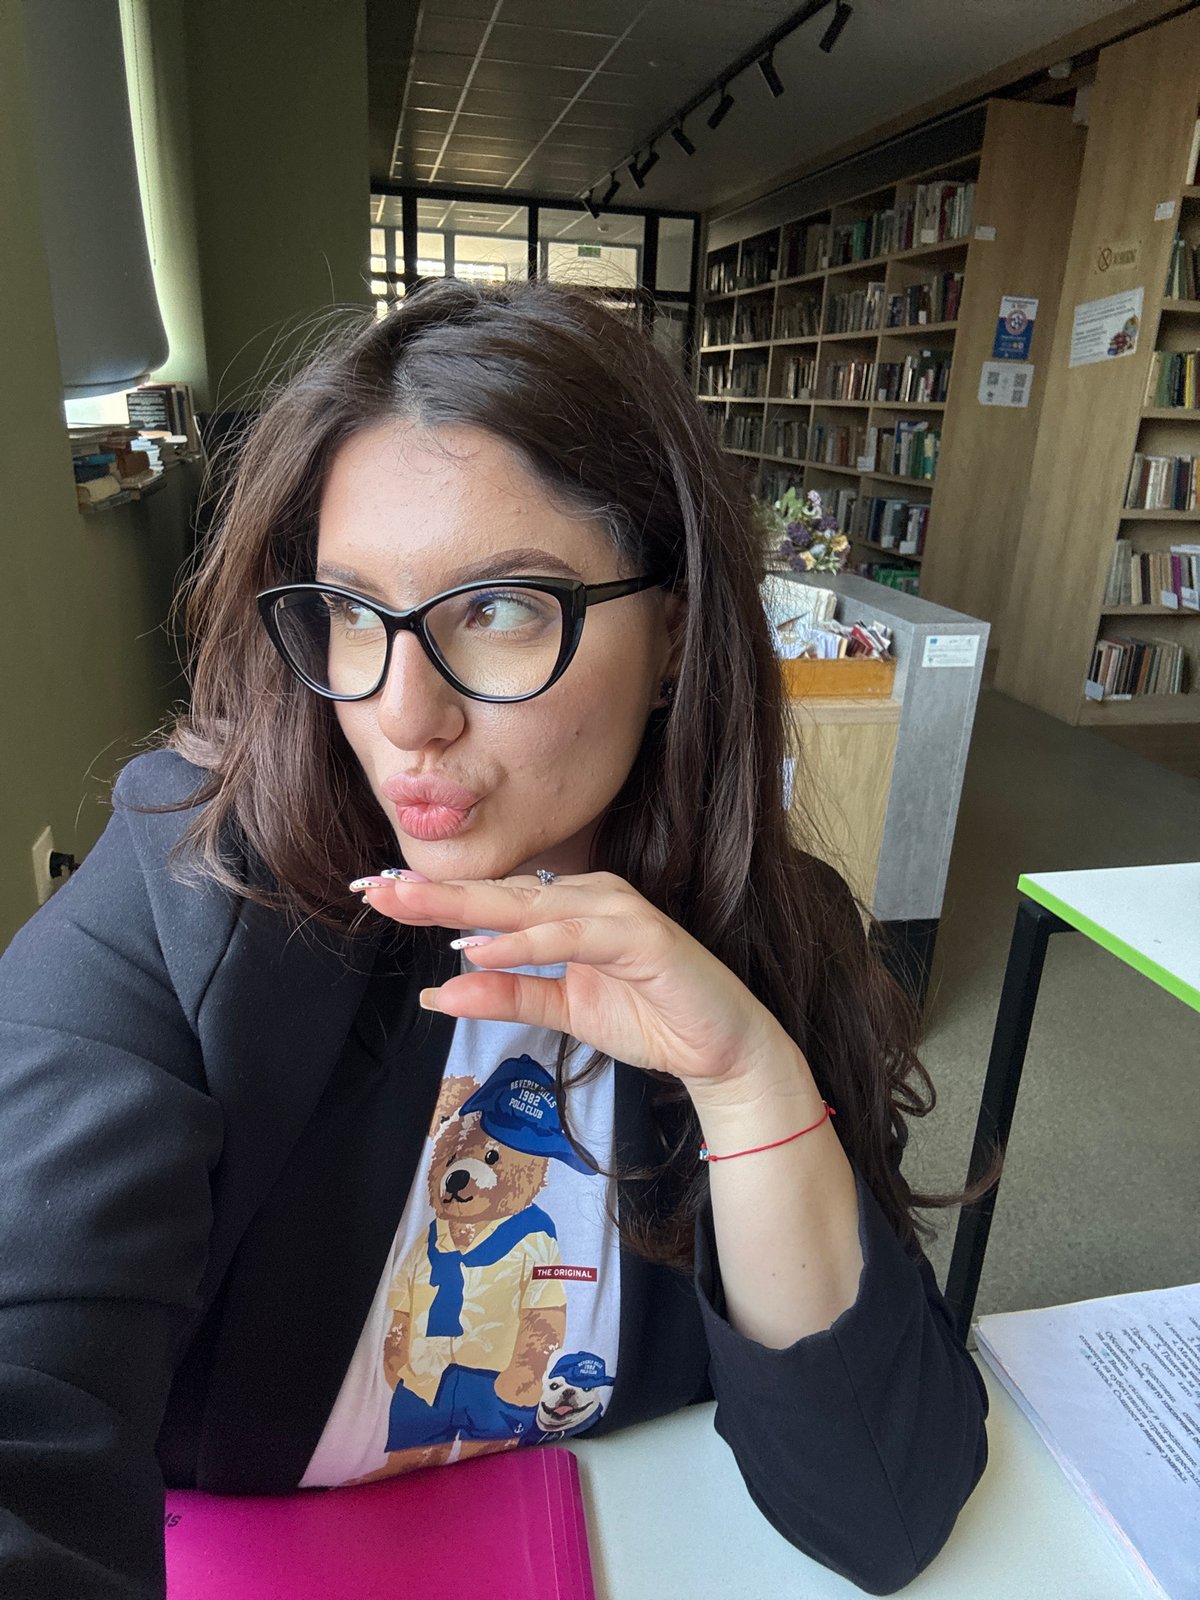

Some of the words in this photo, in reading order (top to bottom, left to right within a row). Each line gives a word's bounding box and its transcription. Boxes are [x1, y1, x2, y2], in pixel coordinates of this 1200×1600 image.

[510, 1080, 540, 1091] BEVERLY
[519, 1089, 541, 1106] 1982
[508, 1097, 526, 1111] POLO
[525, 1104, 544, 1119] CLUB
[554, 1268, 592, 1278] ORIGINAL
[1159, 1350, 1188, 1378] Понятие
[1077, 1334, 1105, 1364] елементи
[1107, 1373, 1149, 1418] субективната
[1144, 1419, 1168, 1443] страна
[1103, 1330, 1147, 1379] Обстоятелства,
[1143, 1379, 1164, 1399] които
[1160, 1399, 1195, 1436] изключват
[1107, 1359, 1125, 1377] Вина
[1126, 1383, 1155, 1413] същност
[1139, 1361, 1178, 1403] Обществена
[1176, 1381, 1194, 1397] като
[1110, 1388, 1141, 1422] Същност
[1141, 1428, 1166, 1454] видове
[1159, 1453, 1191, 1484] умисъл.
